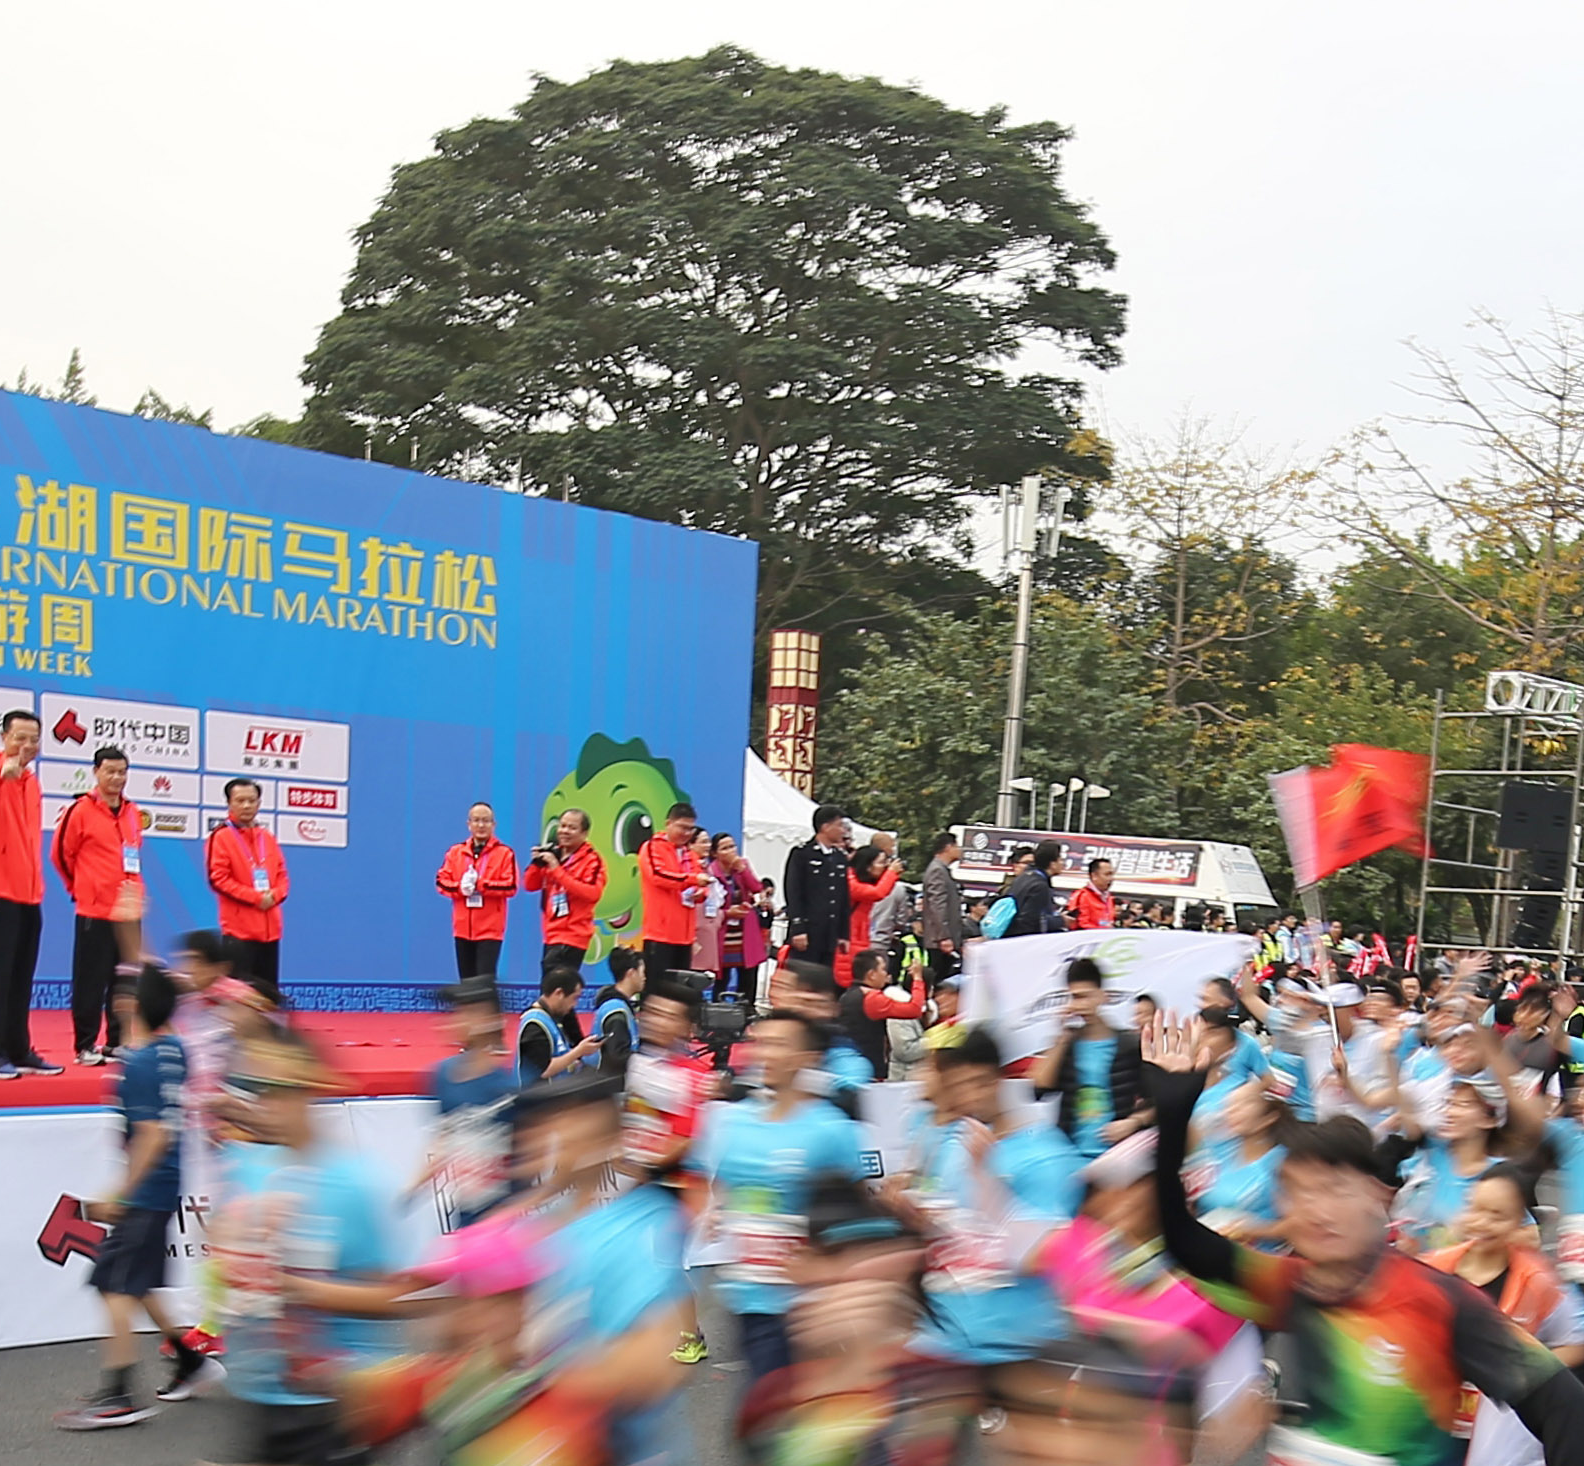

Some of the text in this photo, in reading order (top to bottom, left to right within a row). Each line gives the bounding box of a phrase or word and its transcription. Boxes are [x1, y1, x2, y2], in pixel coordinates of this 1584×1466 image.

[273, 588, 498, 650] MARATHON
[13, 647, 92, 678] WEEK
[93, 717, 191, 746] 时代中国
[245, 730, 302, 754] LKM
